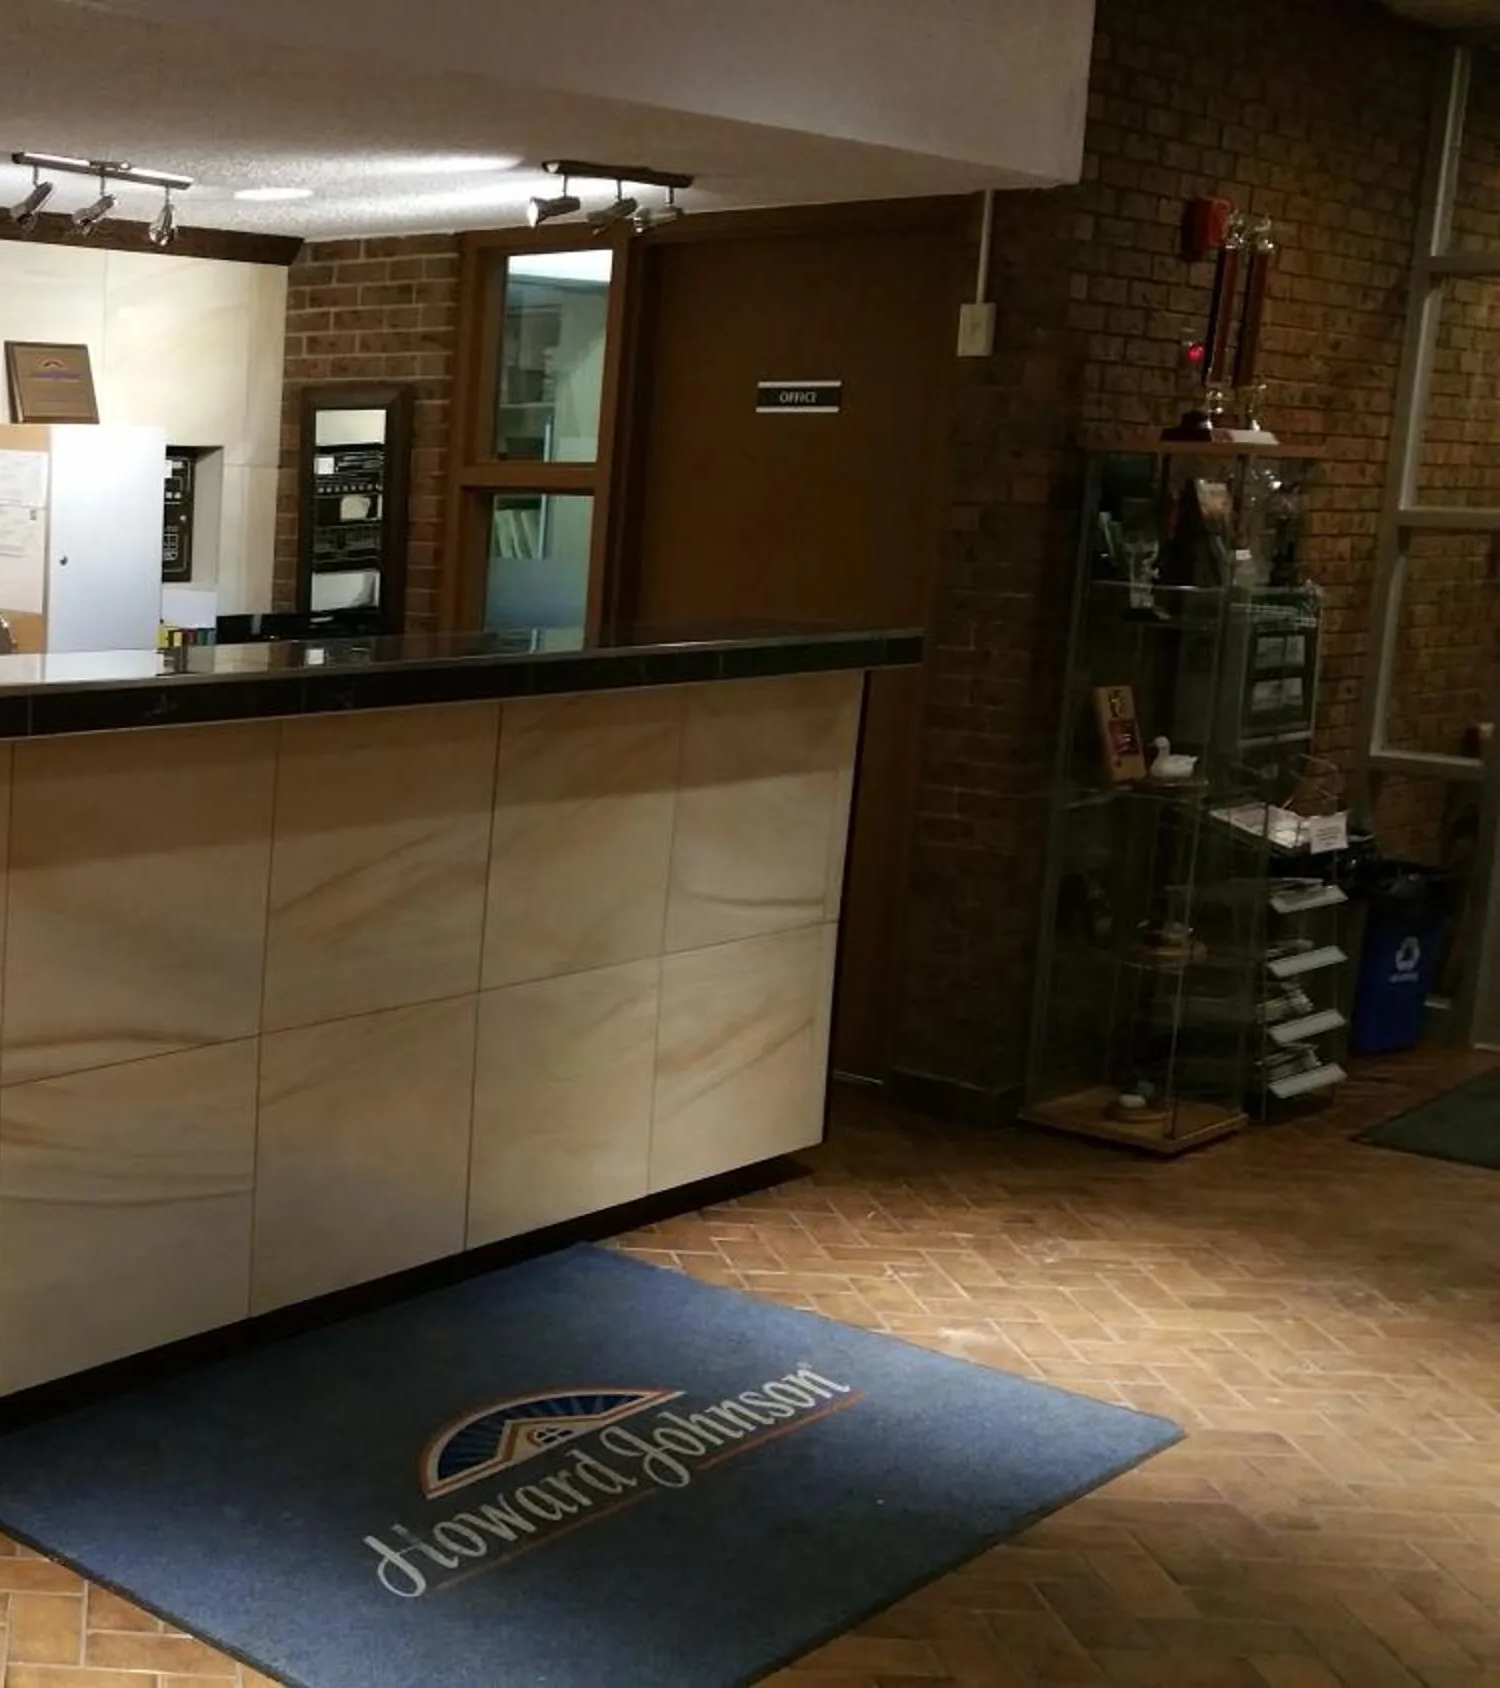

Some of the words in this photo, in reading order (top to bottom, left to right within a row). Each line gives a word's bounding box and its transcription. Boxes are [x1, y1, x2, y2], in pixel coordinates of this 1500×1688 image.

[779, 391, 817, 404] OFFICE
[364, 1448, 637, 1597] Howard
[601, 1369, 850, 1488] Johnson
